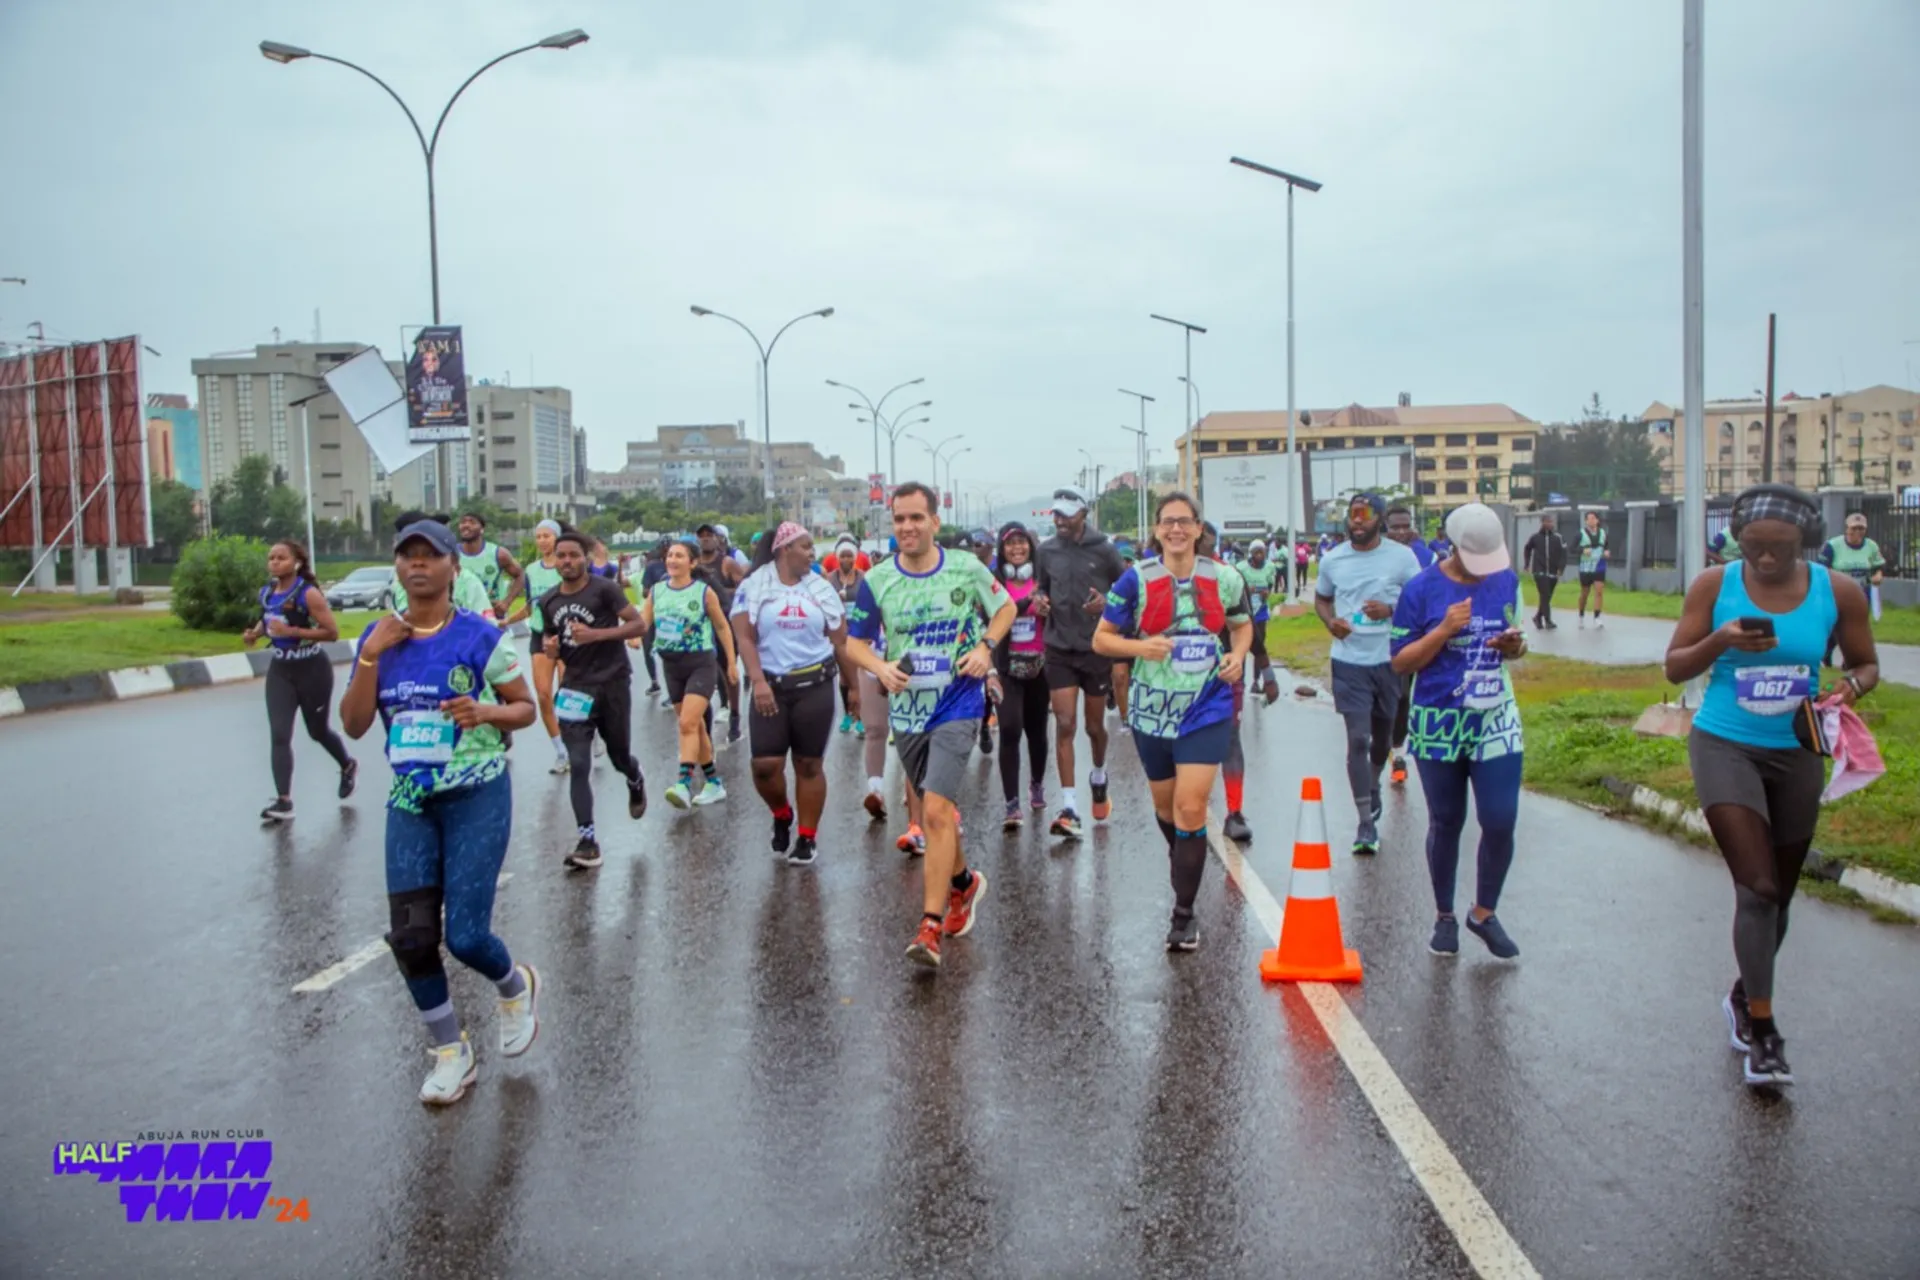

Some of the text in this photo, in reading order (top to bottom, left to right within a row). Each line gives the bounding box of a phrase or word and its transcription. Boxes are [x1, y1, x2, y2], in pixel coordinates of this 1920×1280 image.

[570, 603, 595, 623] CLUB
[413, 685, 439, 695] BANK
[1752, 680, 1795, 697] 0617
[401, 726, 443, 744] 0566
